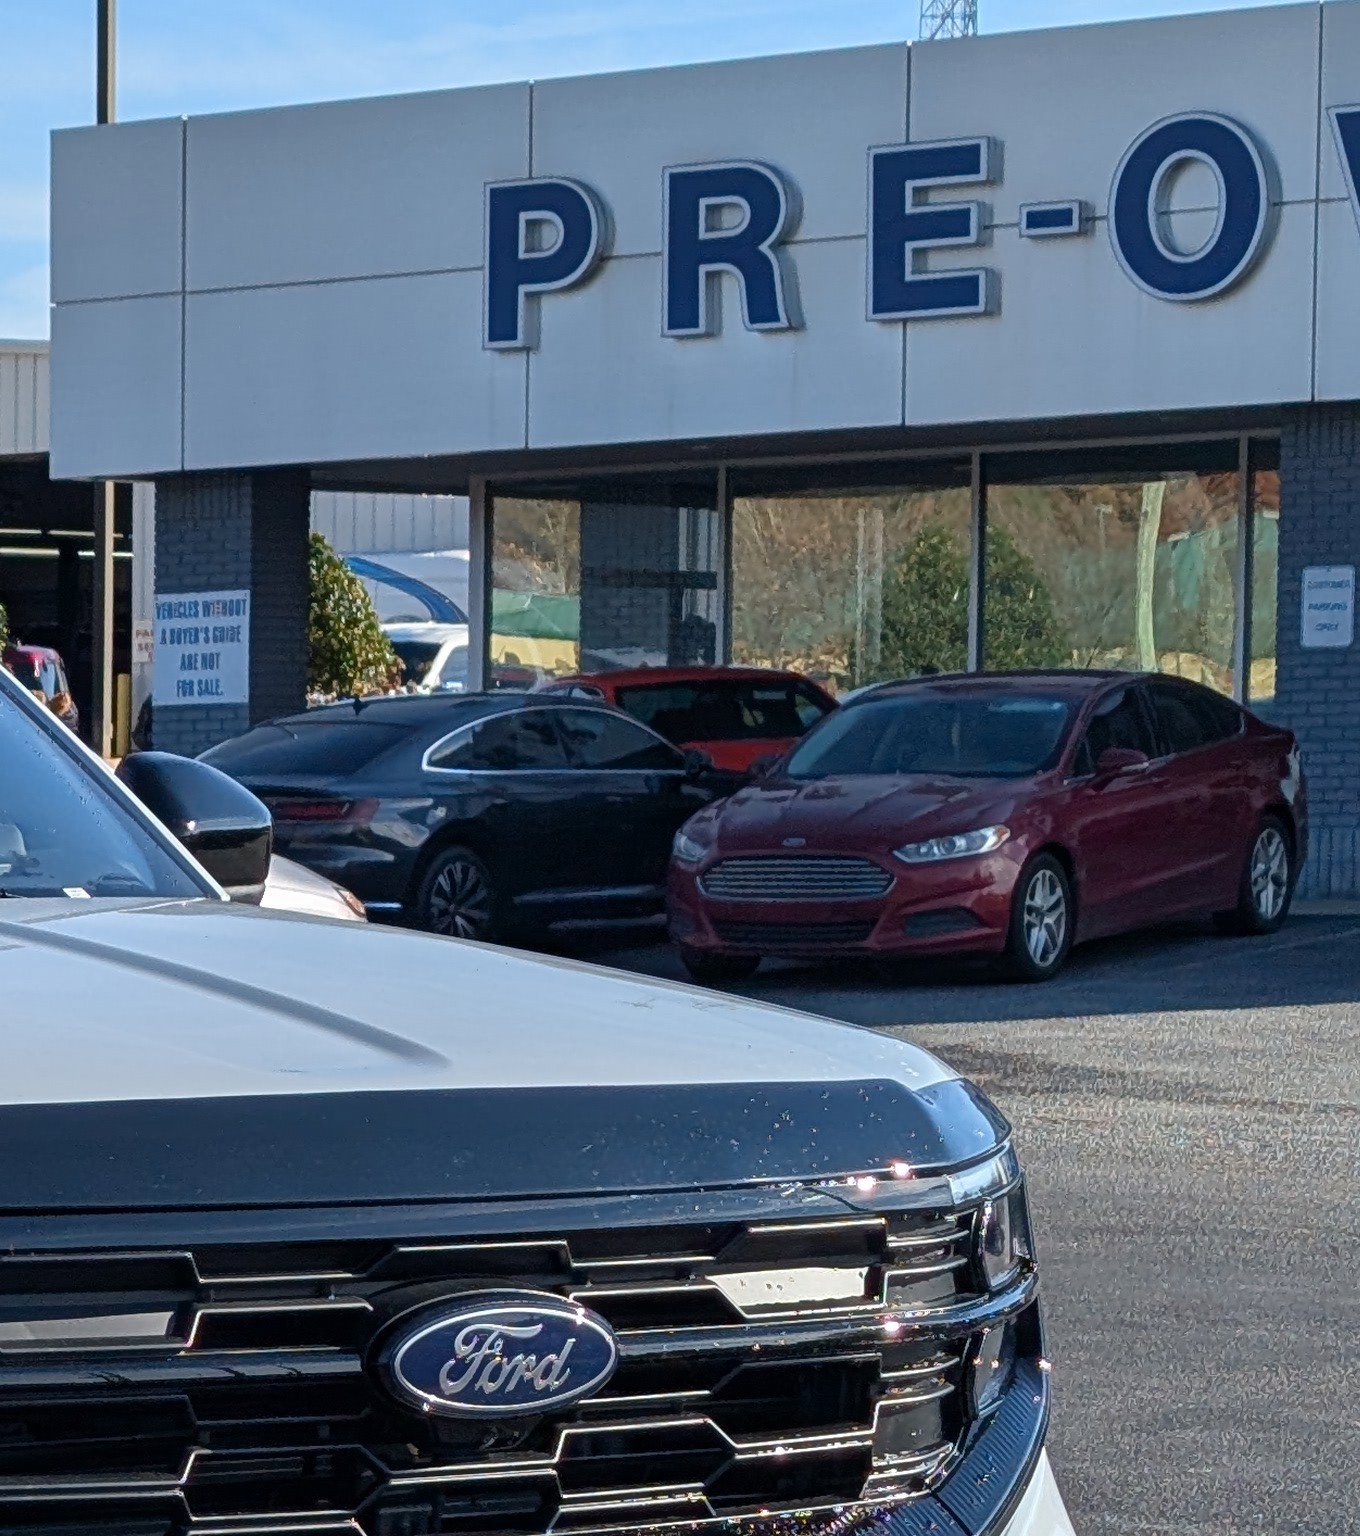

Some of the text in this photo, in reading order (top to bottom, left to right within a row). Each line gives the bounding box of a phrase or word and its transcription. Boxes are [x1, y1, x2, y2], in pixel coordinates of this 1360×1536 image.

[482, 103, 1360, 350] PRE-O
[156, 599, 247, 620] VEHICLES WITHOUT
[160, 628, 167, 645] A
[169, 626, 210, 645] BUYER'S
[212, 625, 241, 644] GUIDE
[180, 652, 220, 671] ARE NOT
[176, 678, 224, 698] FOR SALE.
[438, 1322, 577, 1396] Ford
